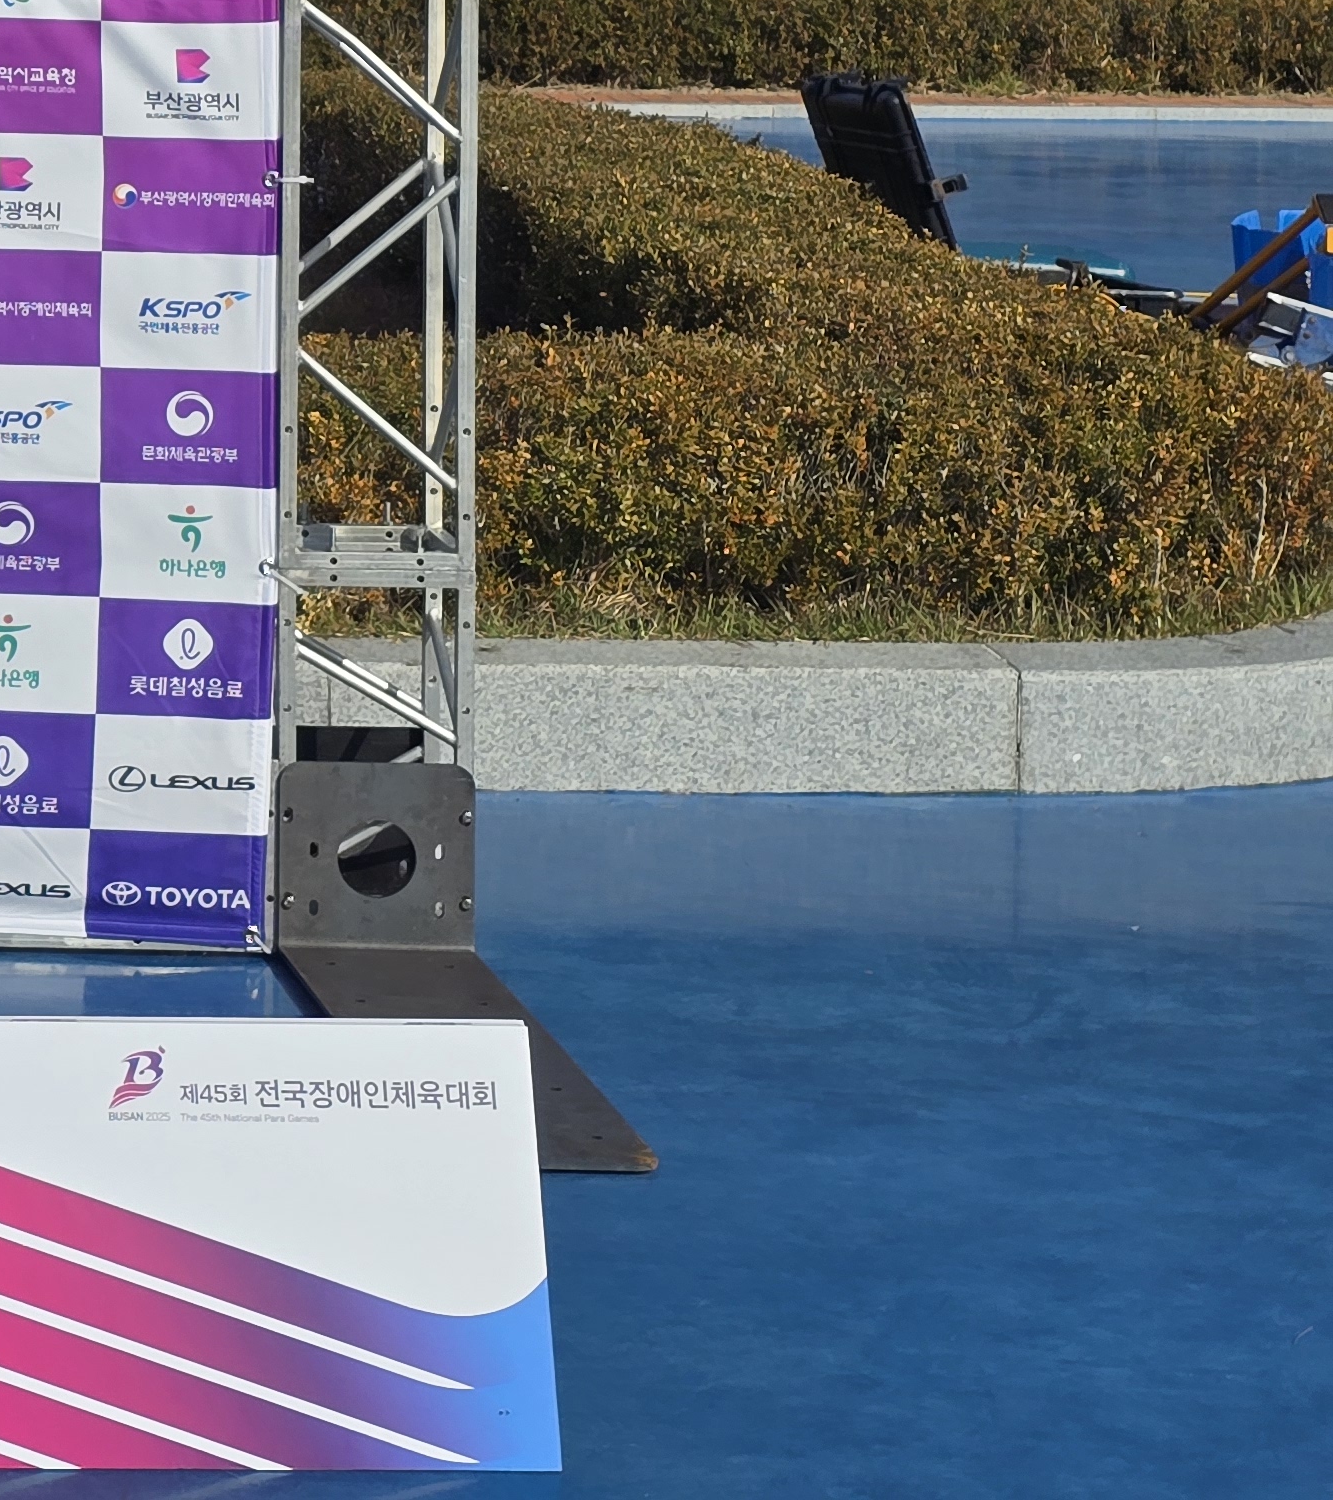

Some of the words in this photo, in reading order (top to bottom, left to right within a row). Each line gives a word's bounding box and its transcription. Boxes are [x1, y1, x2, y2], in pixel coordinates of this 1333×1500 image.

[143, 90, 240, 113] 부산광역시
[139, 188, 275, 209] 부산광역시장애인체육회
[139, 297, 223, 320] KSPO
[141, 444, 239, 465] 문화체육관광부
[159, 556, 227, 580] 하나은행
[128, 676, 244, 700] 롯데칠성음료
[146, 773, 256, 792] LEXUS
[145, 886, 251, 911] TOYOTA
[179, 1082, 249, 1106] 제45회
[253, 1078, 498, 1112] 전국장애인체육대회
[108, 1111, 144, 1122] BUSAN
